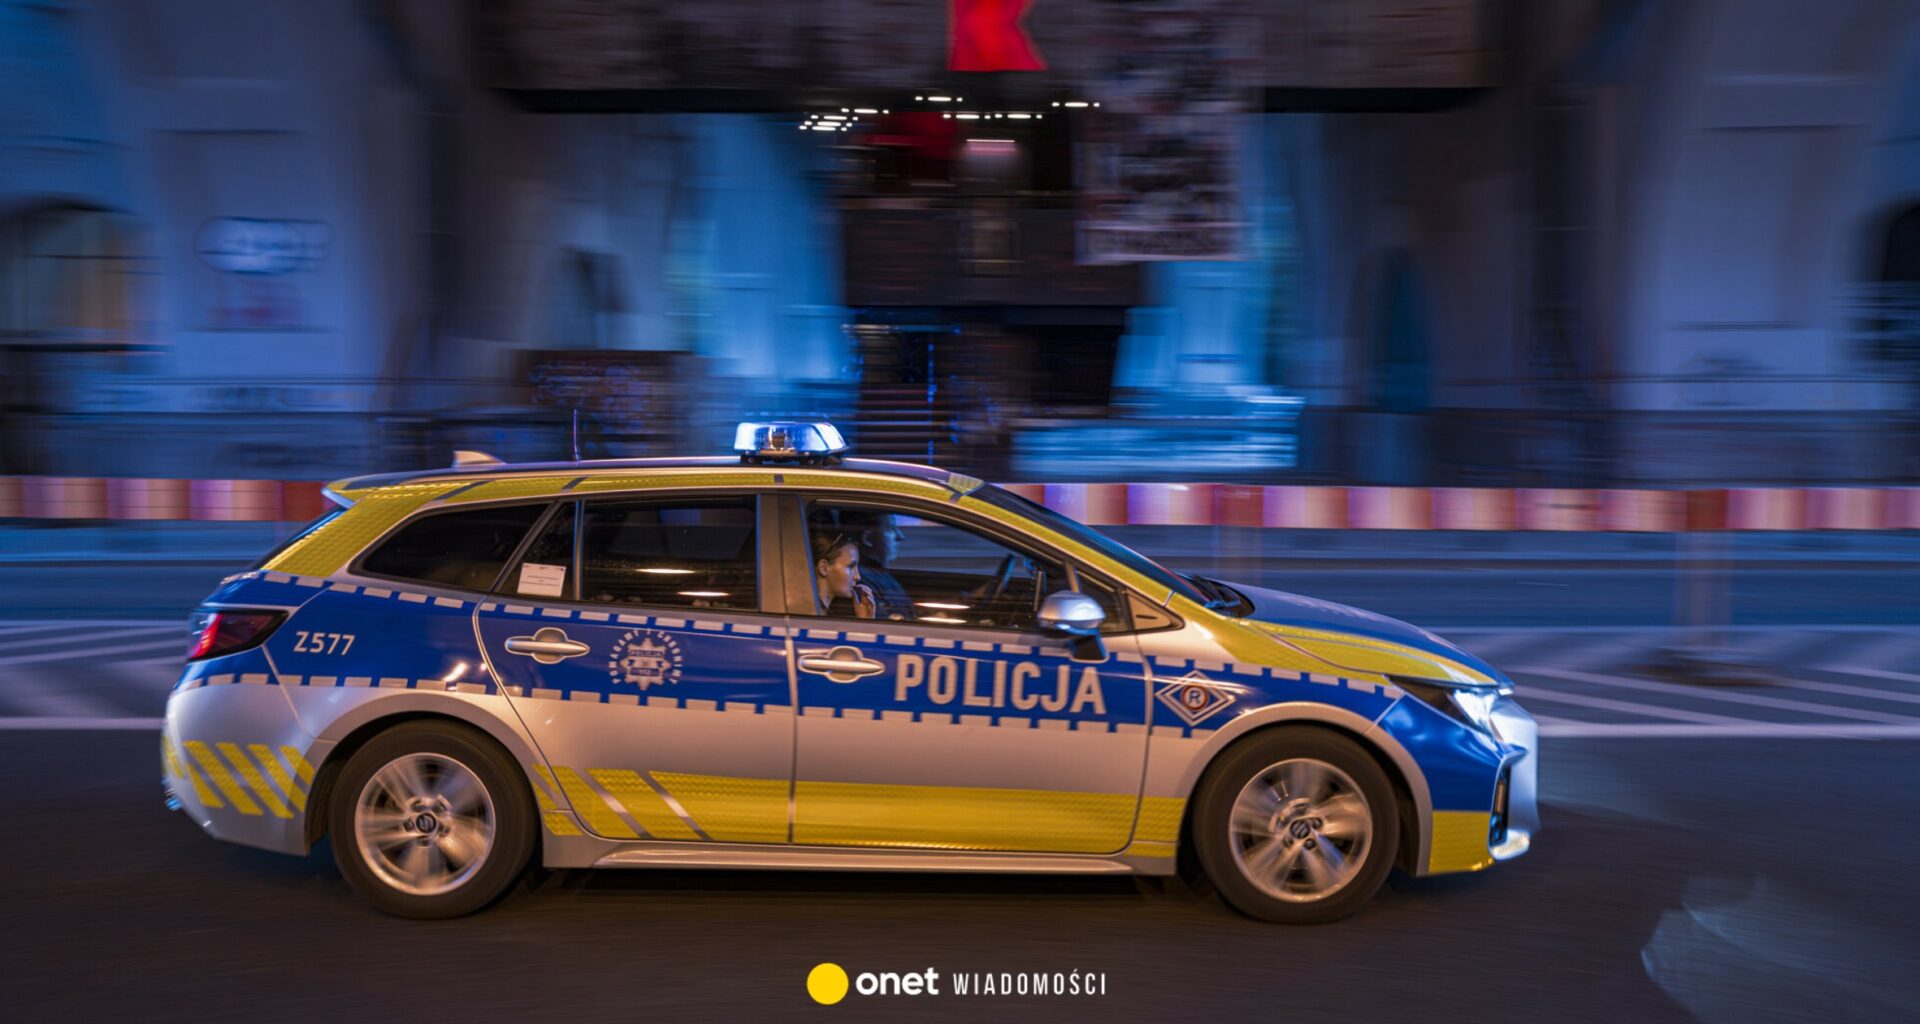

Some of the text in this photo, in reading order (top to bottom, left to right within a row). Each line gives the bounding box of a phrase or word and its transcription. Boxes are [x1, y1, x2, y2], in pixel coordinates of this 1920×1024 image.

[293, 631, 355, 656] Z577
[894, 653, 1107, 715] POLICJA
[1188, 689, 1201, 705] R
